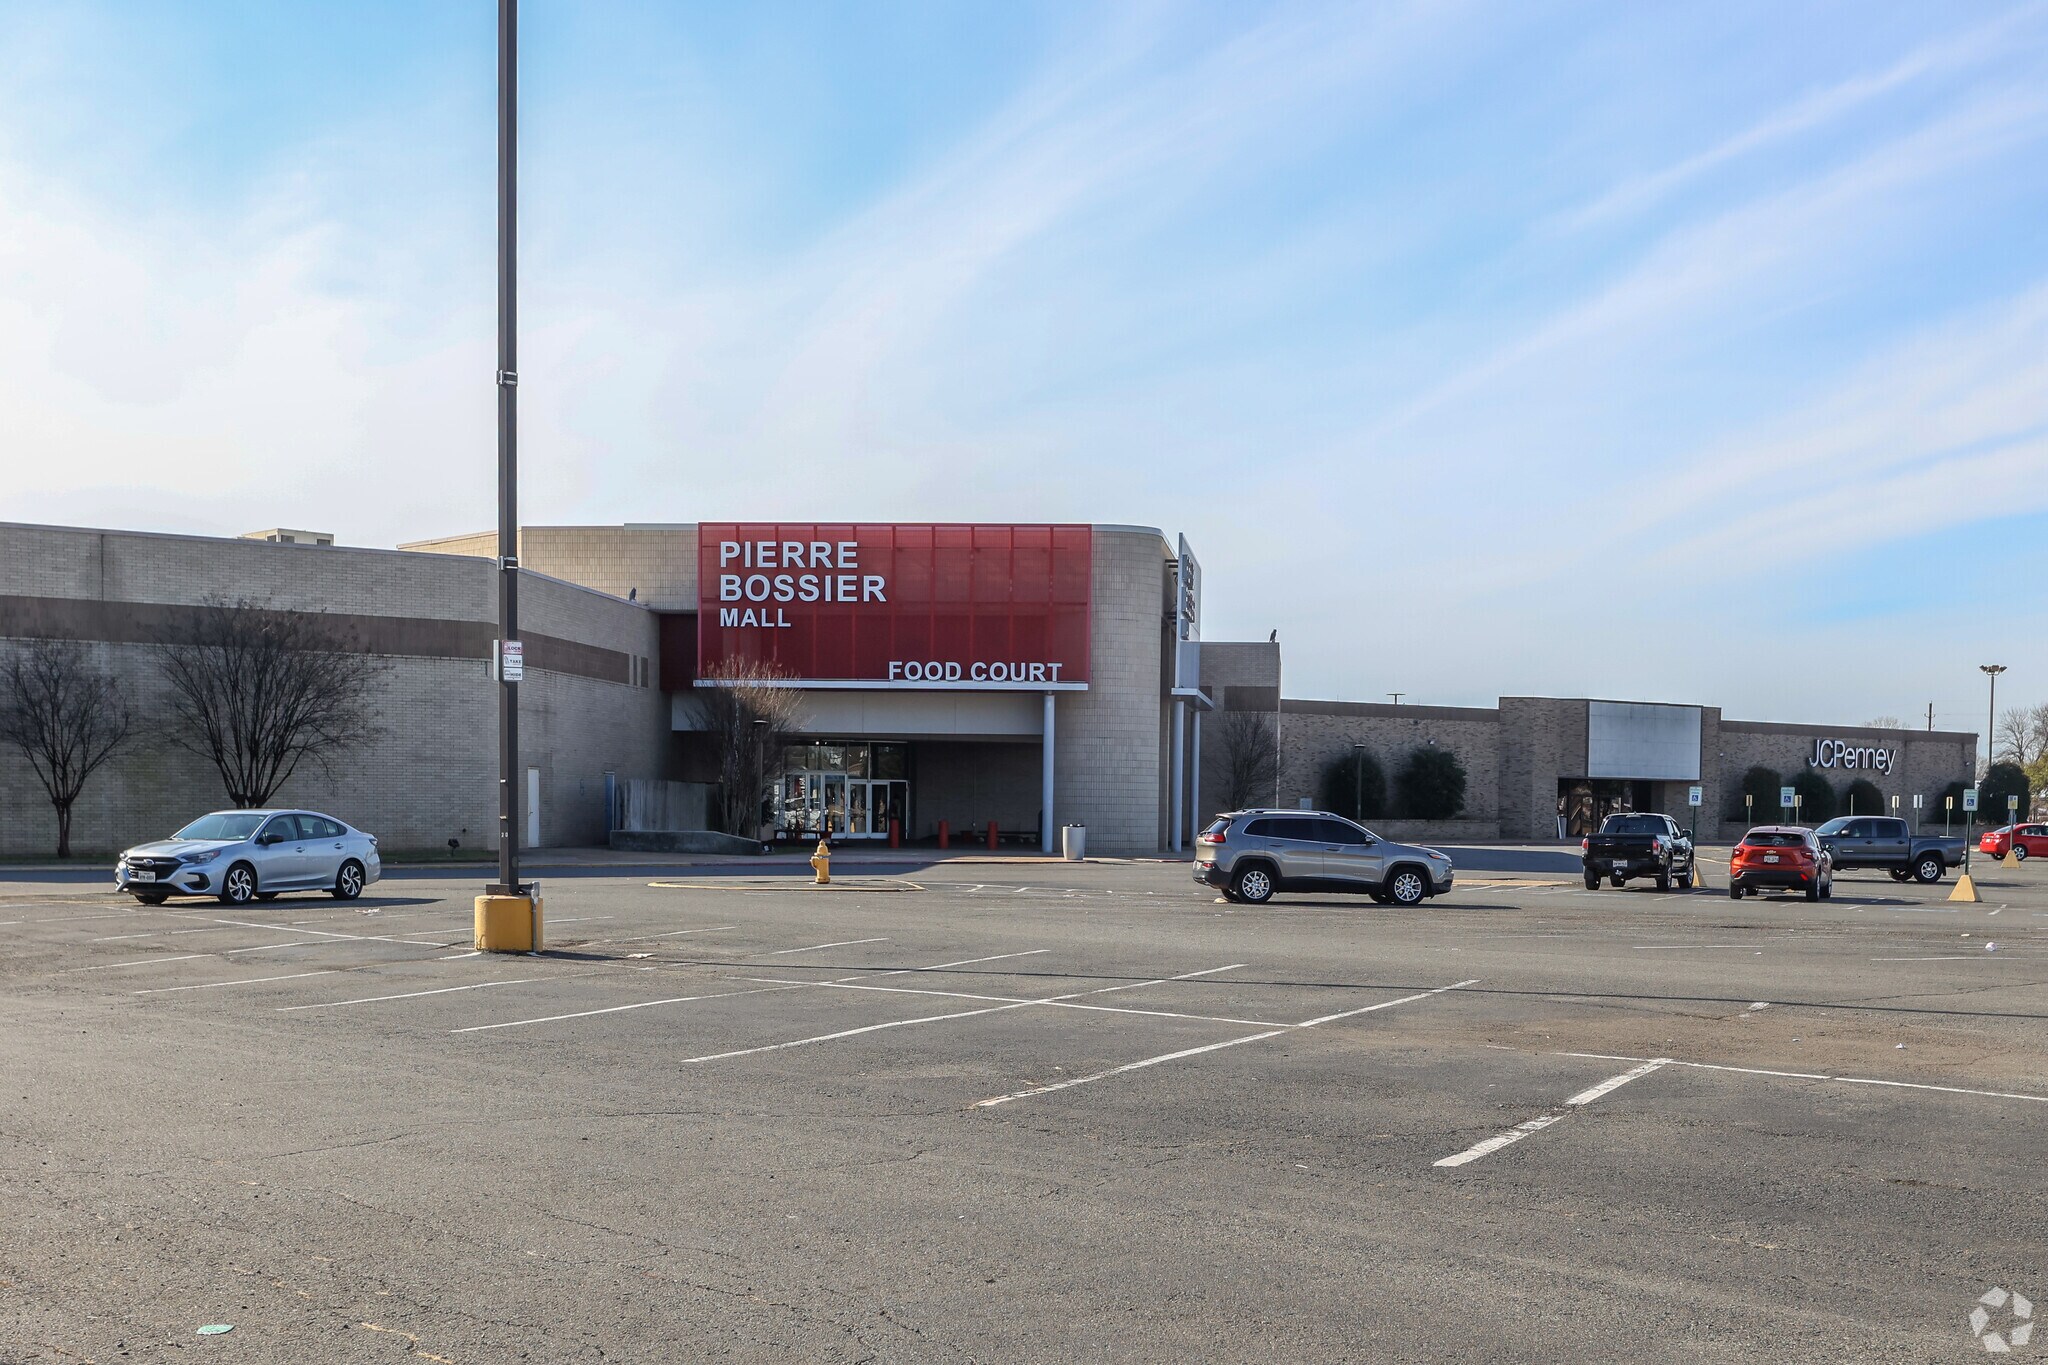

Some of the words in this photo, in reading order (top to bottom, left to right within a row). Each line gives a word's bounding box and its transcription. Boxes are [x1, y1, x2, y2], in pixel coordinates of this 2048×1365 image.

[719, 541, 859, 569] PIERRE
[719, 574, 888, 603] BOSSIER
[719, 608, 792, 628] MALL
[888, 661, 963, 682] FOOD
[970, 662, 1063, 683] COURT
[1808, 739, 1897, 776] JCPenney
